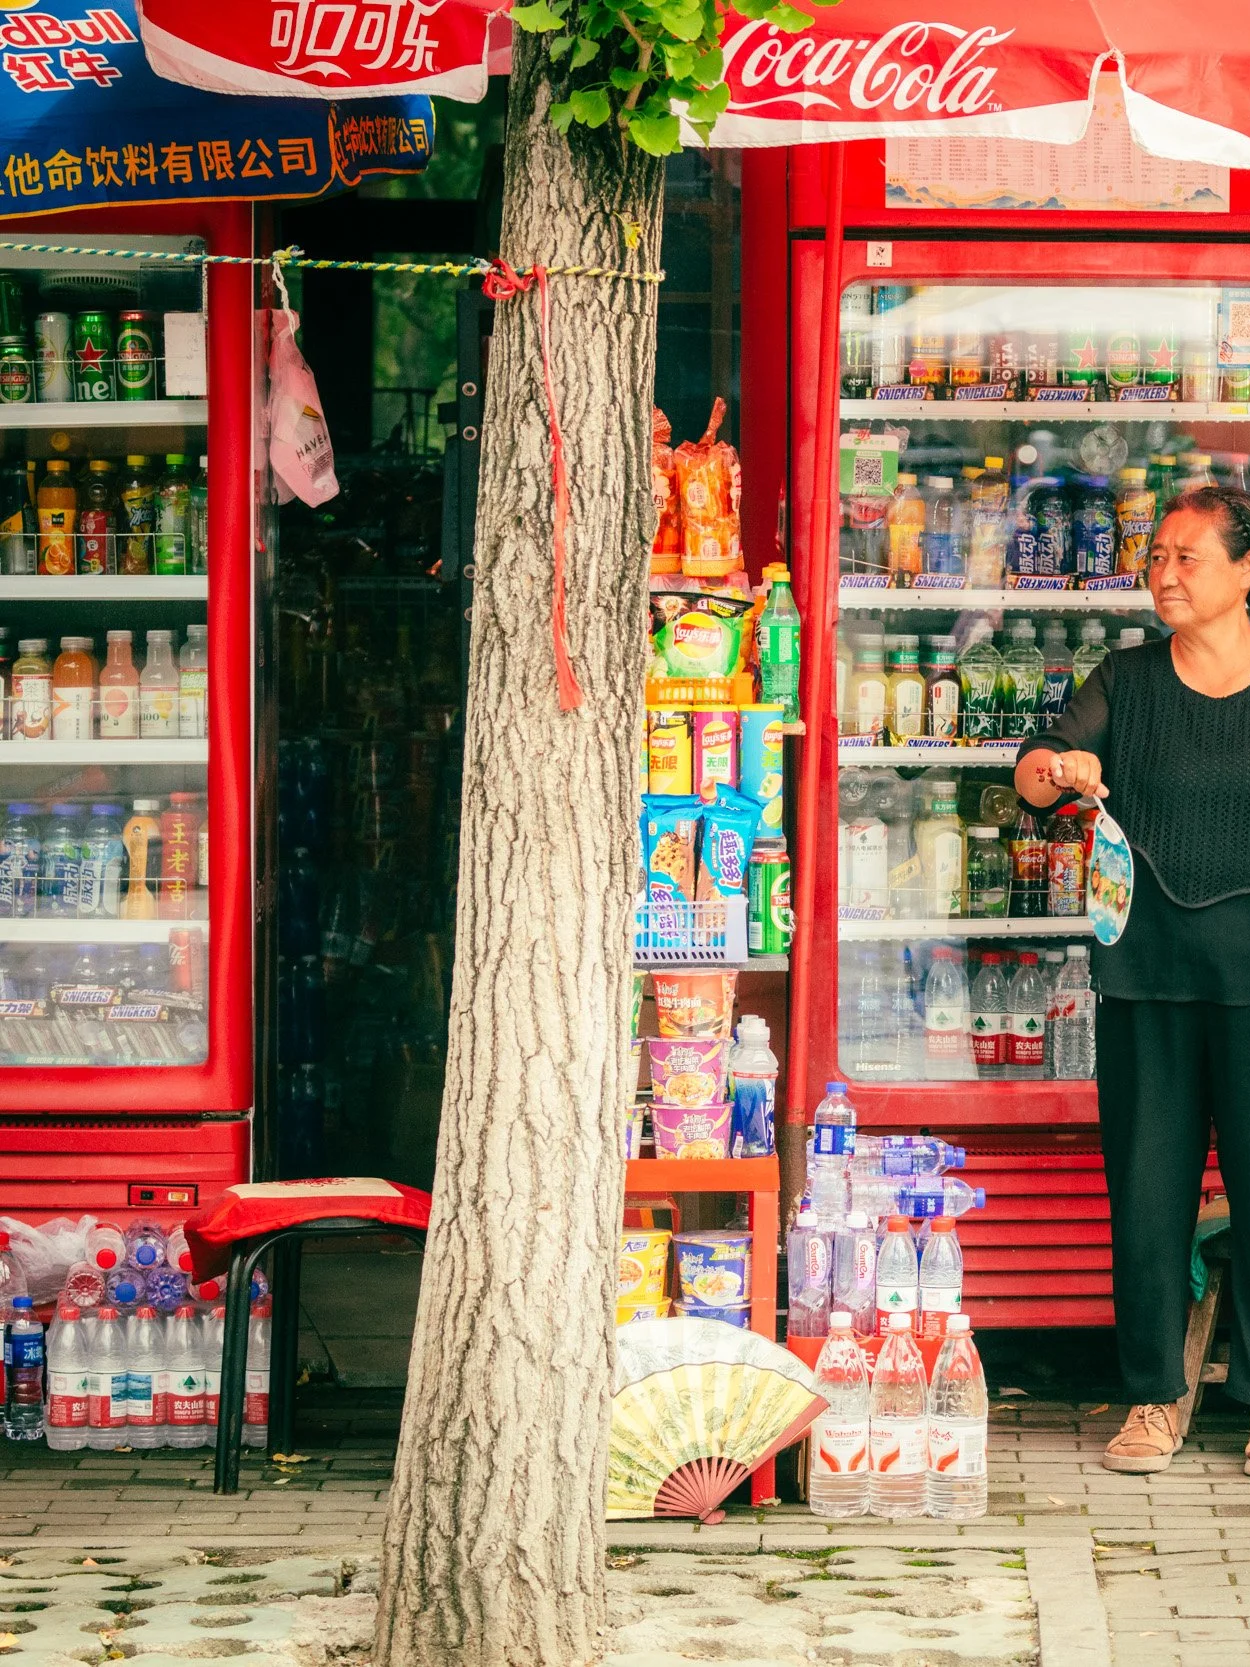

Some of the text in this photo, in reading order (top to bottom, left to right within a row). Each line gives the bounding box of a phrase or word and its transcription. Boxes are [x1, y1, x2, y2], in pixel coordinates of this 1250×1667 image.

[0, 9, 138, 48] dBull
[271, 0, 445, 74] 可口可乐
[3, 48, 122, 93] 红牛
[719, 18, 1016, 114] Coca-Cola
[0, 137, 317, 197] 他命饮料有限公司
[877, 387, 925, 400] SNICKERS
[955, 384, 1006, 400] SNICKERS
[1120, 386, 1168, 400] SNICKERS
[840, 575, 889, 588] SNICKERS
[915, 575, 963, 588] SNICKERS
[1086, 575, 1134, 590] SNICKERS
[167, 822, 190, 902] 王老吉
[838, 906, 884, 920] SNICKERS
[61, 990, 112, 1004] SNICKERS
[110, 1005, 158, 1018] SNICKERS
[855, 1062, 902, 1072] Hisense
